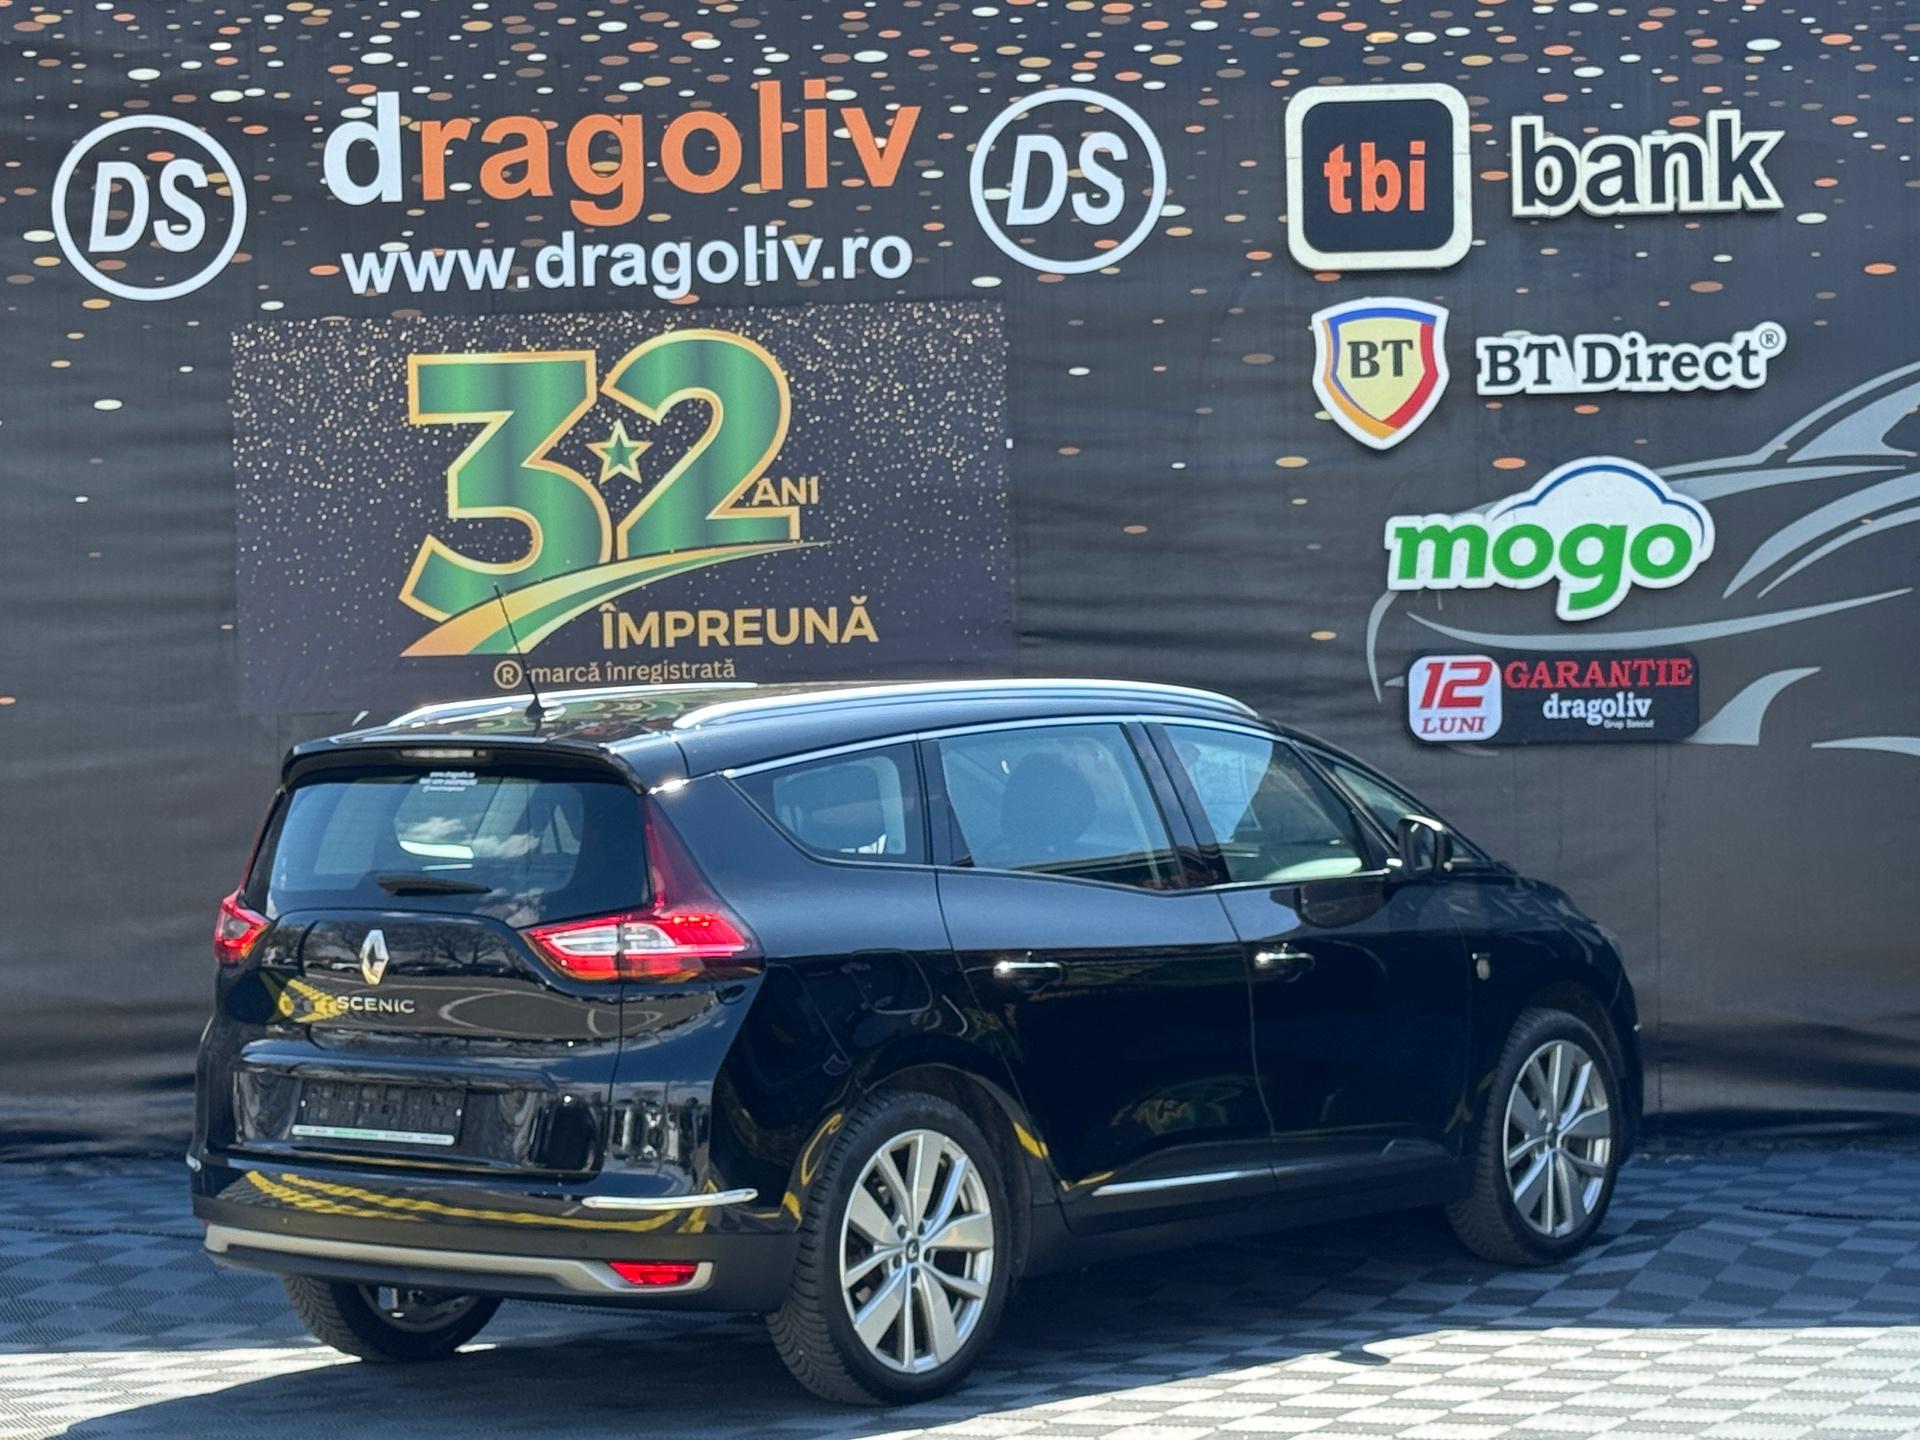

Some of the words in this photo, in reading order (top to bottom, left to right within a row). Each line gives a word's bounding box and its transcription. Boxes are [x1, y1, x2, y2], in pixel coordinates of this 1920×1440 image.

[324, 80, 921, 227] dragoliv
[1323, 140, 1427, 214] tbi
[1511, 109, 1785, 218] bank
[1005, 132, 1128, 226] DS
[88, 159, 209, 253] DS
[340, 225, 913, 300] www.dragoliv.ro
[1346, 339, 1414, 379] BT
[1484, 344, 1560, 387] BT
[398, 328, 801, 624] 32
[750, 476, 820, 506] ANI
[1395, 523, 1692, 610] mogo
[600, 597, 879, 650] ÎMPREUNĂ
[529, 661, 601, 684] marcă
[606, 657, 736, 684] înregistrată
[1420, 661, 1492, 708] 12
[1504, 659, 1692, 688] GARANTIE
[1422, 715, 1486, 734] LUNI
[1543, 692, 1652, 726] dragoliv
[336, 996, 415, 1013] SCENIC
